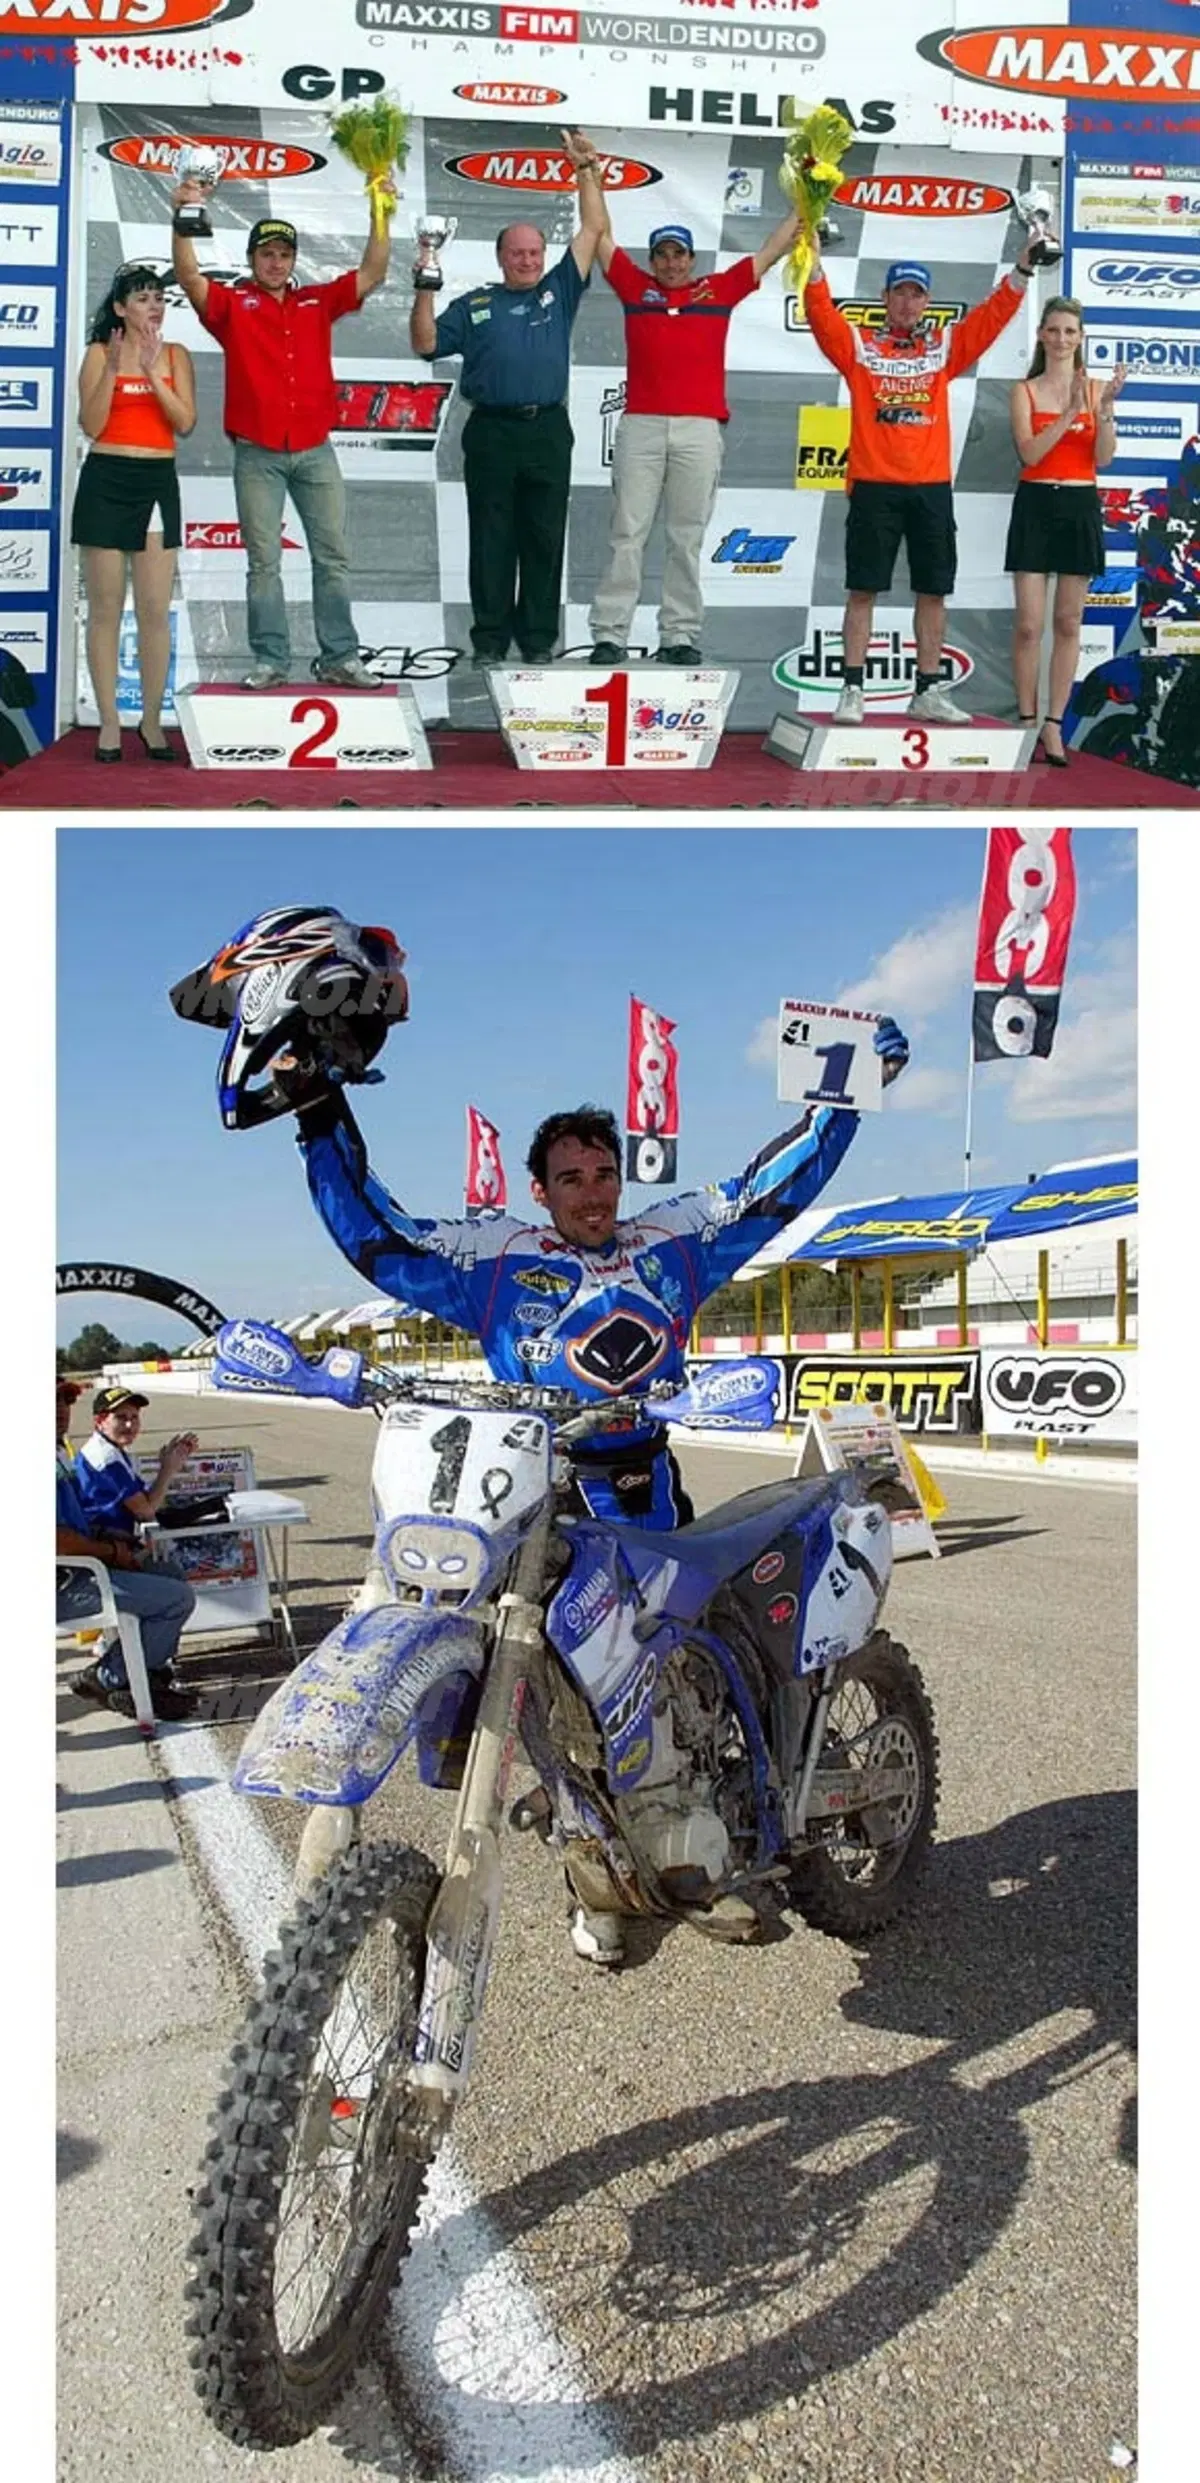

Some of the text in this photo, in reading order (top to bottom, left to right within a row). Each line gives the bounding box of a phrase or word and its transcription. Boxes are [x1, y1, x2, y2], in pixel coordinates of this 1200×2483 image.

[364, 4, 819, 53] MAXXIS FIM WORLDENDURO
[367, 34, 816, 76] CHAMPIONSHIP
[281, 64, 386, 101] GP
[472, 84, 549, 104] MAXXIS
[1079, 163, 1130, 176] MAXXIS
[1134, 166, 1164, 178] FIM
[851, 181, 985, 211] MAXXIS
[1096, 264, 1200, 285] UFO
[1115, 420, 1182, 438] usqvarna
[288, 697, 341, 769] 2
[585, 672, 629, 767] 1
[649, 708, 707, 730] Agio
[900, 728, 931, 772] 3
[803, 1042, 857, 1106] 1
[797, 1371, 966, 1416] SCOTT
[996, 1368, 1116, 1399] UFO
[1013, 1419, 1097, 1434] PLAST
[430, 1414, 474, 1515] 1
